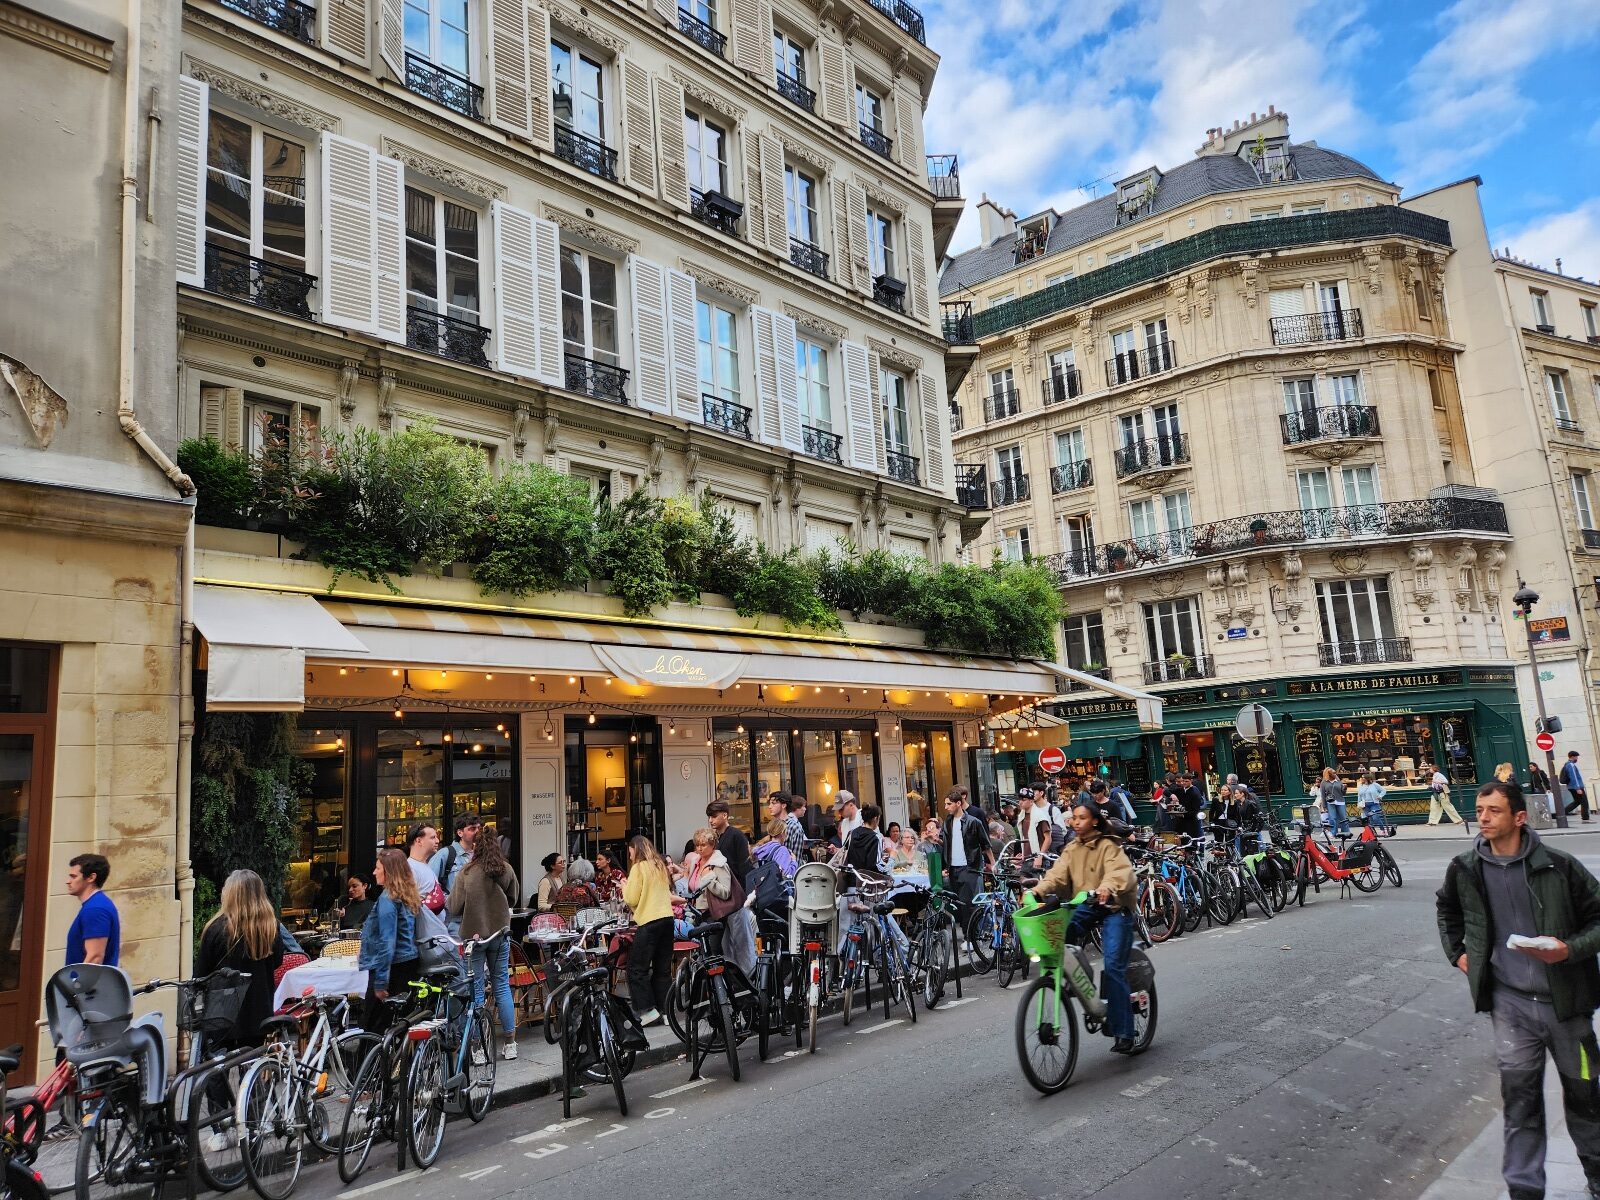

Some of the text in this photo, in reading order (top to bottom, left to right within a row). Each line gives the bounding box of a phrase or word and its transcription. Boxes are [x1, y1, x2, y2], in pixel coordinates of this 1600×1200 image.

[1320, 681, 1334, 692] LA
[1337, 678, 1368, 691] MÈRE
[1371, 678, 1386, 688] DE
[1389, 675, 1439, 687] FAMILLE
[1067, 706, 1079, 716] LA
[1081, 702, 1107, 715] MÈRE
[1110, 702, 1122, 712] DE
